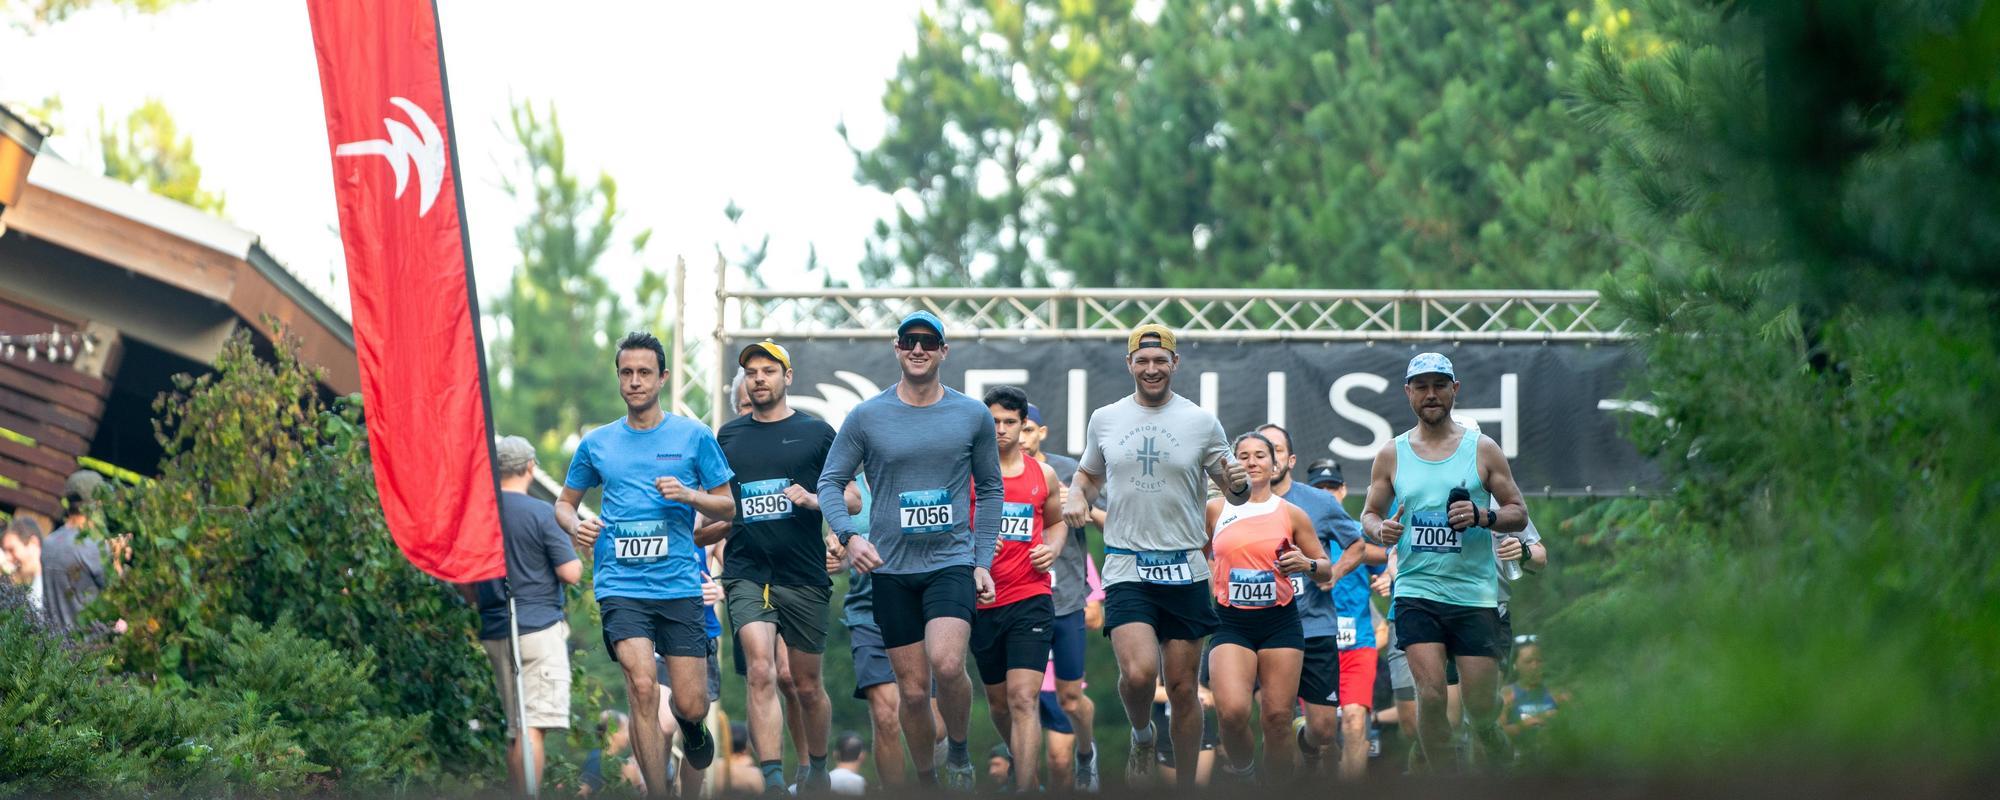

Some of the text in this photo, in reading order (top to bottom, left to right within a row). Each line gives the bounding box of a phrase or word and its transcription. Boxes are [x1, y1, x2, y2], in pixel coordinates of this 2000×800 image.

[964, 368, 1519, 460] FIISH
[1118, 425, 1157, 446] WARRIOR
[1129, 476, 1167, 489] SOCIETY
[745, 495, 787, 516] 3596
[904, 506, 949, 526] 7056
[999, 517, 1029, 534] 074
[1415, 527, 1458, 546] 7004
[619, 537, 664, 557] 7077
[1141, 565, 1184, 580] 7011
[1232, 583, 1273, 600] 7044
